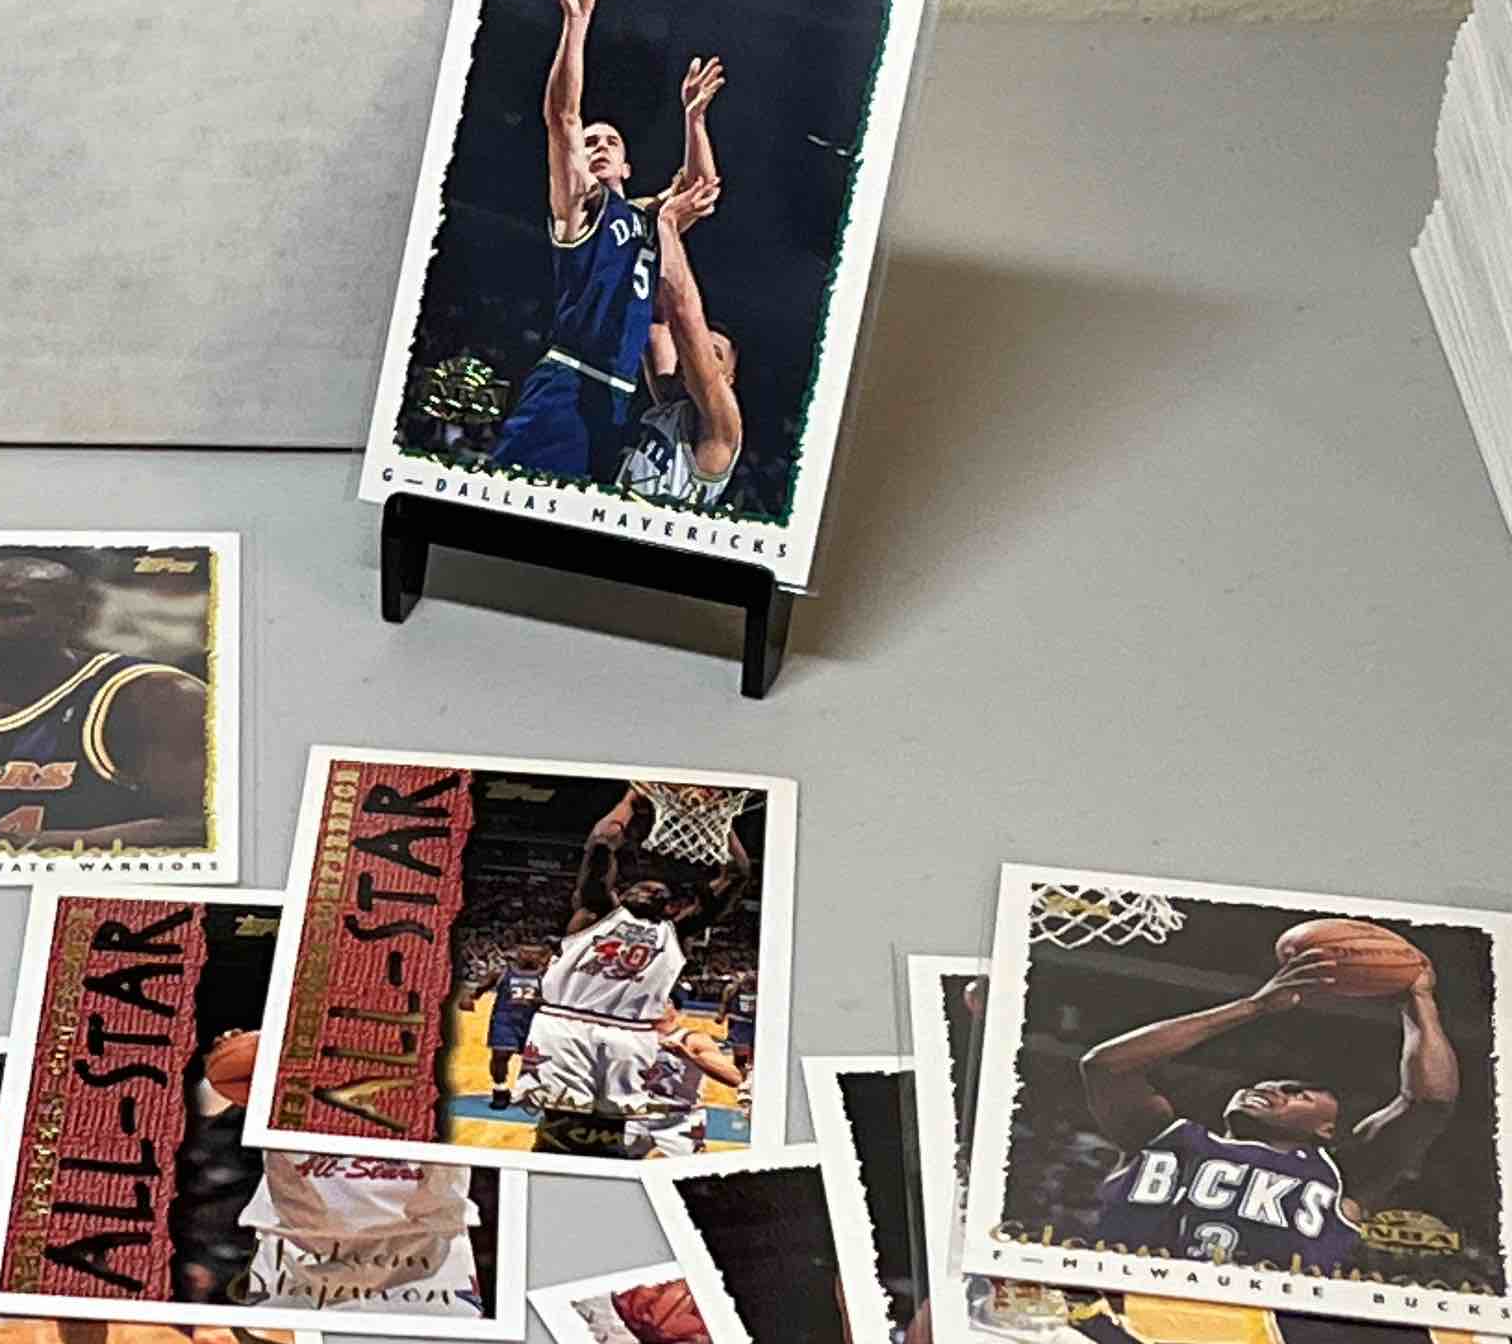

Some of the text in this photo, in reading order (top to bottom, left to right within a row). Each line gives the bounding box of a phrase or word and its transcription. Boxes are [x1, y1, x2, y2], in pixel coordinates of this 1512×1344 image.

[591, 508, 789, 559] MAVERICKS
[79, 861, 219, 873] WARRIORS
[313, 772, 462, 1133] ALL-STAR
[41, 906, 194, 1293] ALL-STAR
[1128, 1149, 1338, 1239] BCKS
[1372, 1292, 1512, 1320] BUCKS
